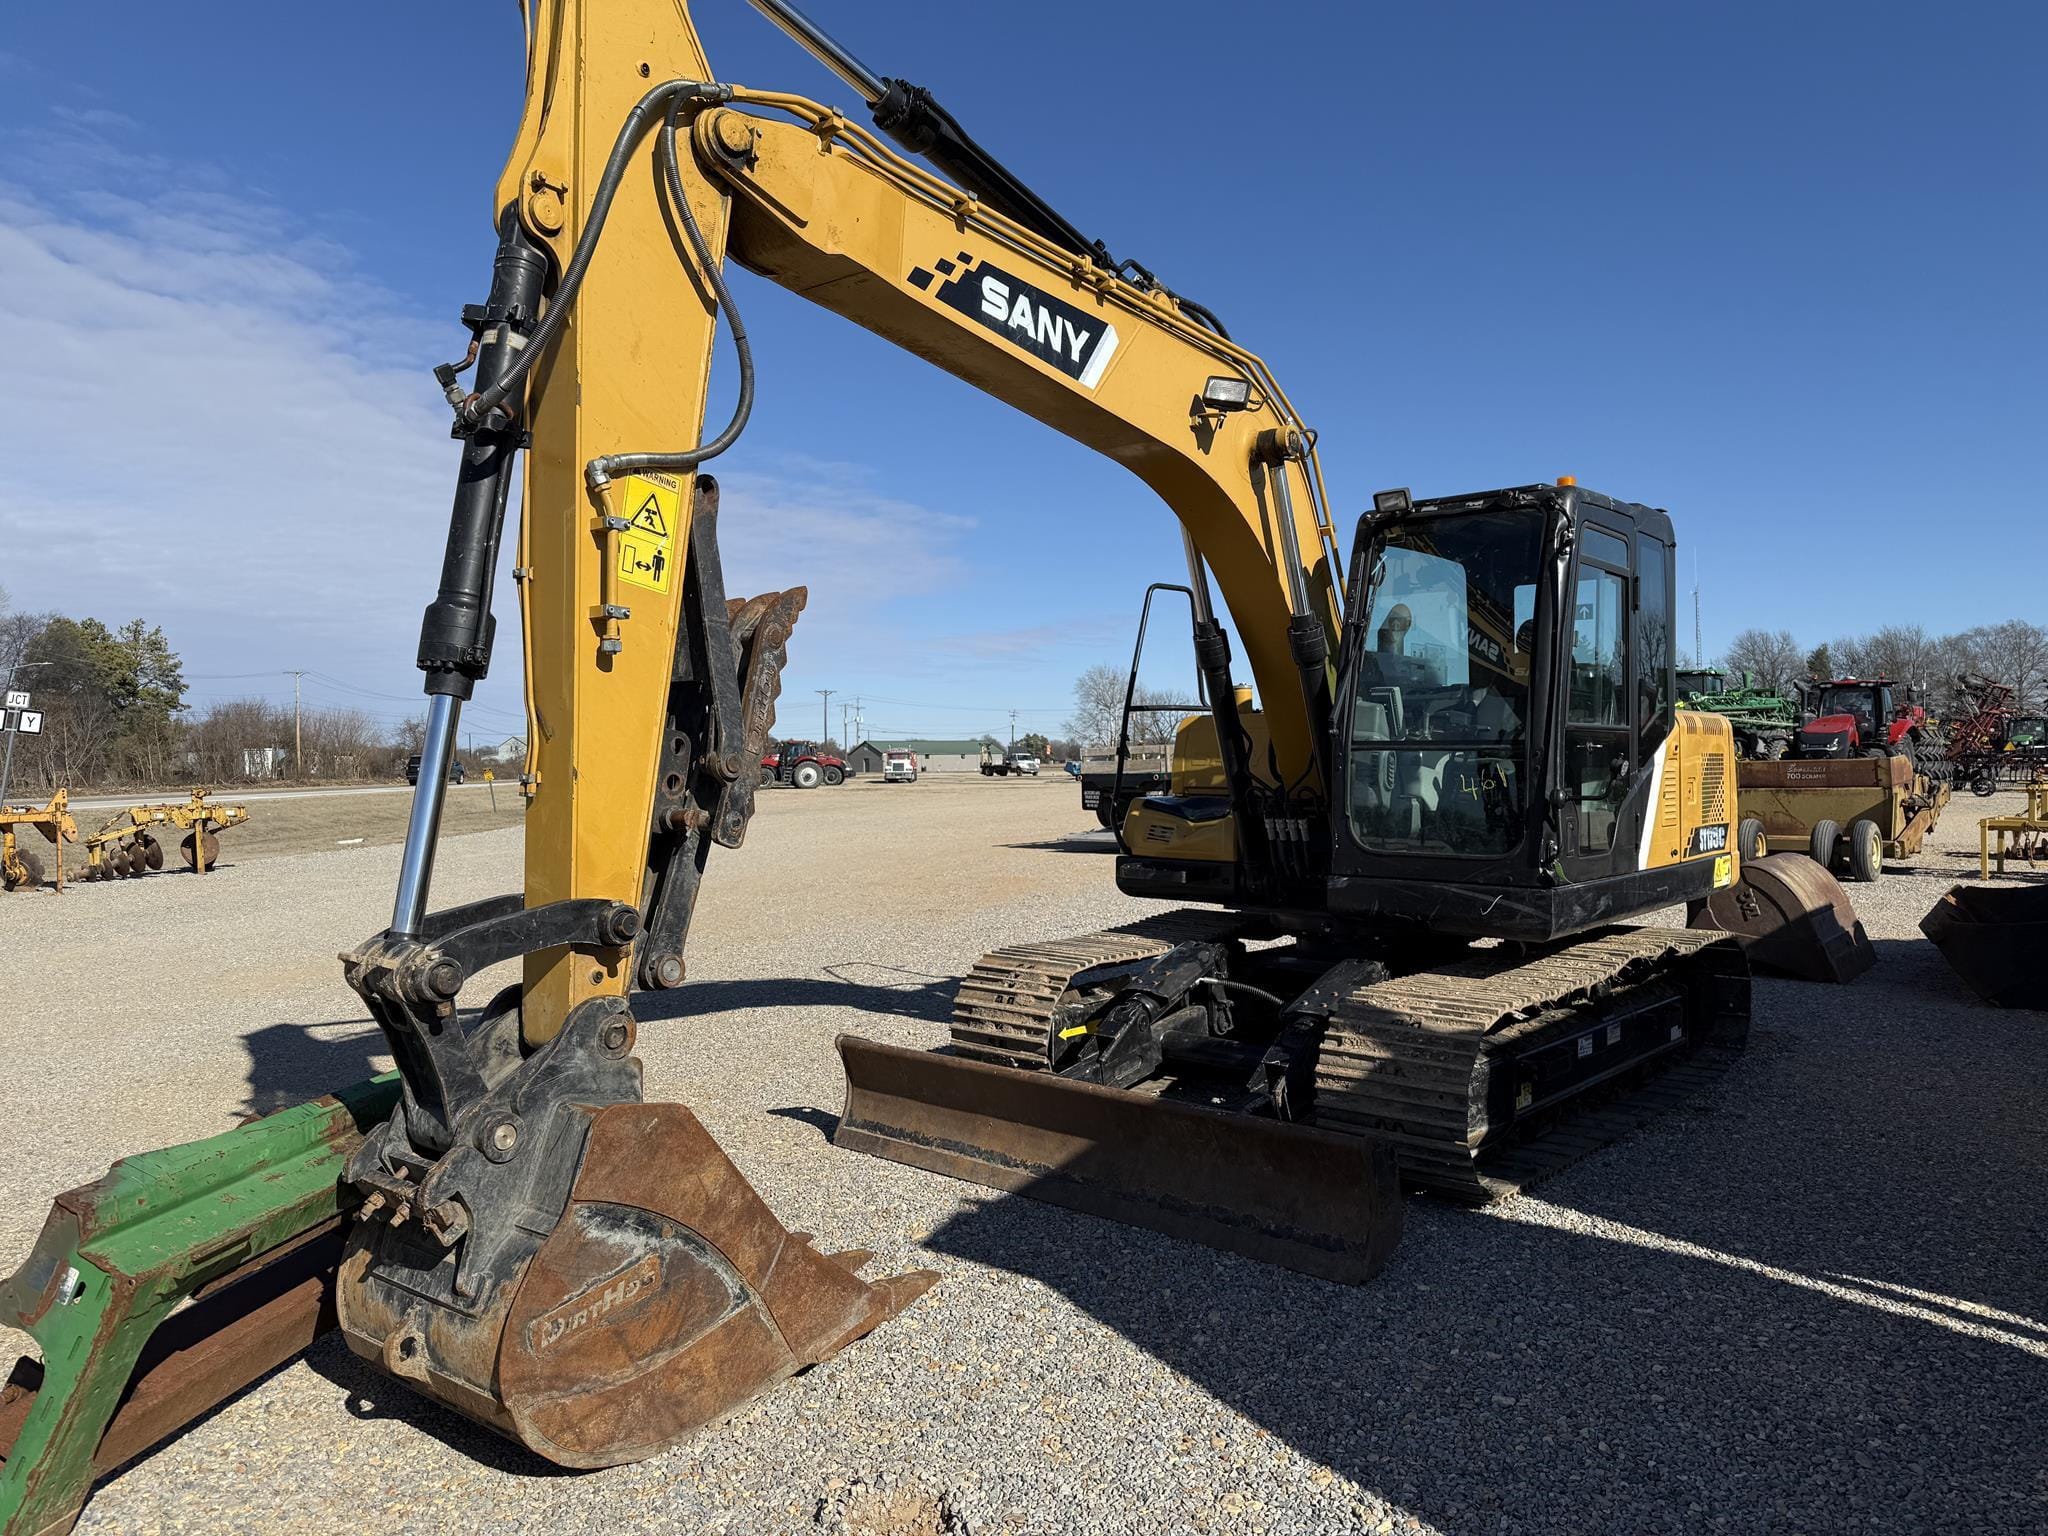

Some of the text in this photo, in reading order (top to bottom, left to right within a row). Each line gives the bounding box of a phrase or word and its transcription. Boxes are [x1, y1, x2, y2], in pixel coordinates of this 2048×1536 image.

[980, 275, 1090, 363] SANY
[642, 468, 677, 489] WARNING
[9, 694, 27, 705] JCT
[27, 716, 36, 728] Y
